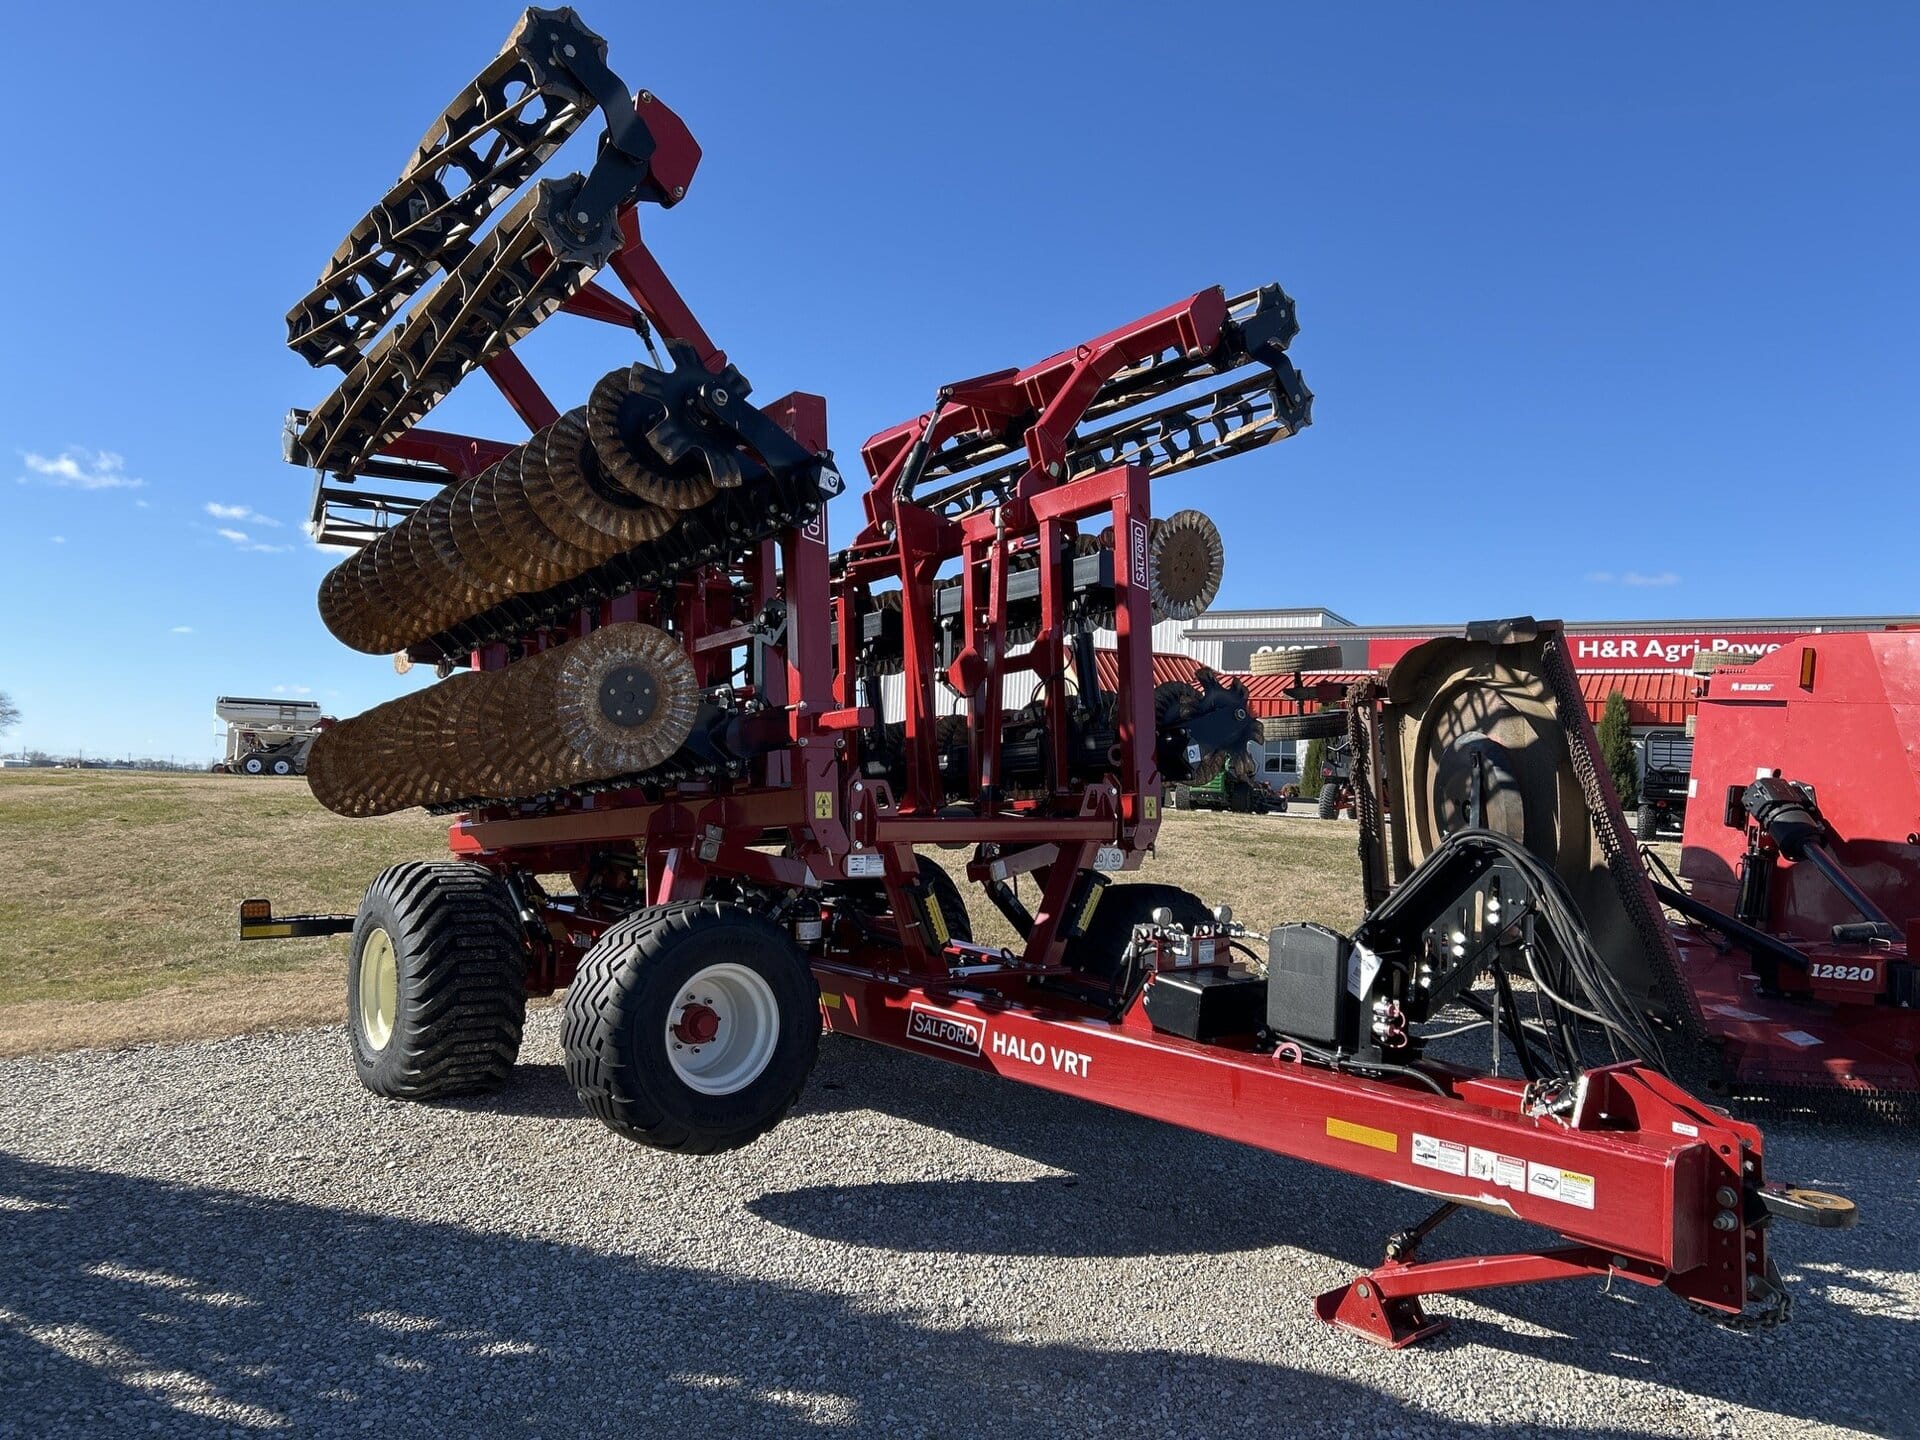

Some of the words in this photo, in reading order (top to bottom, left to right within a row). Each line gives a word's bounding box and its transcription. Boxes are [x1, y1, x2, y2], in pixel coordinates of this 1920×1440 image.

[1134, 526, 1145, 583] SALFORD
[1578, 639, 1639, 659] H&R
[1643, 638, 1782, 662] Agri-Powe
[1811, 963, 1875, 982] 12820
[914, 1012, 978, 1046] SALFORD
[992, 1031, 1046, 1066] HALO
[1050, 1046, 1092, 1078] VRT
